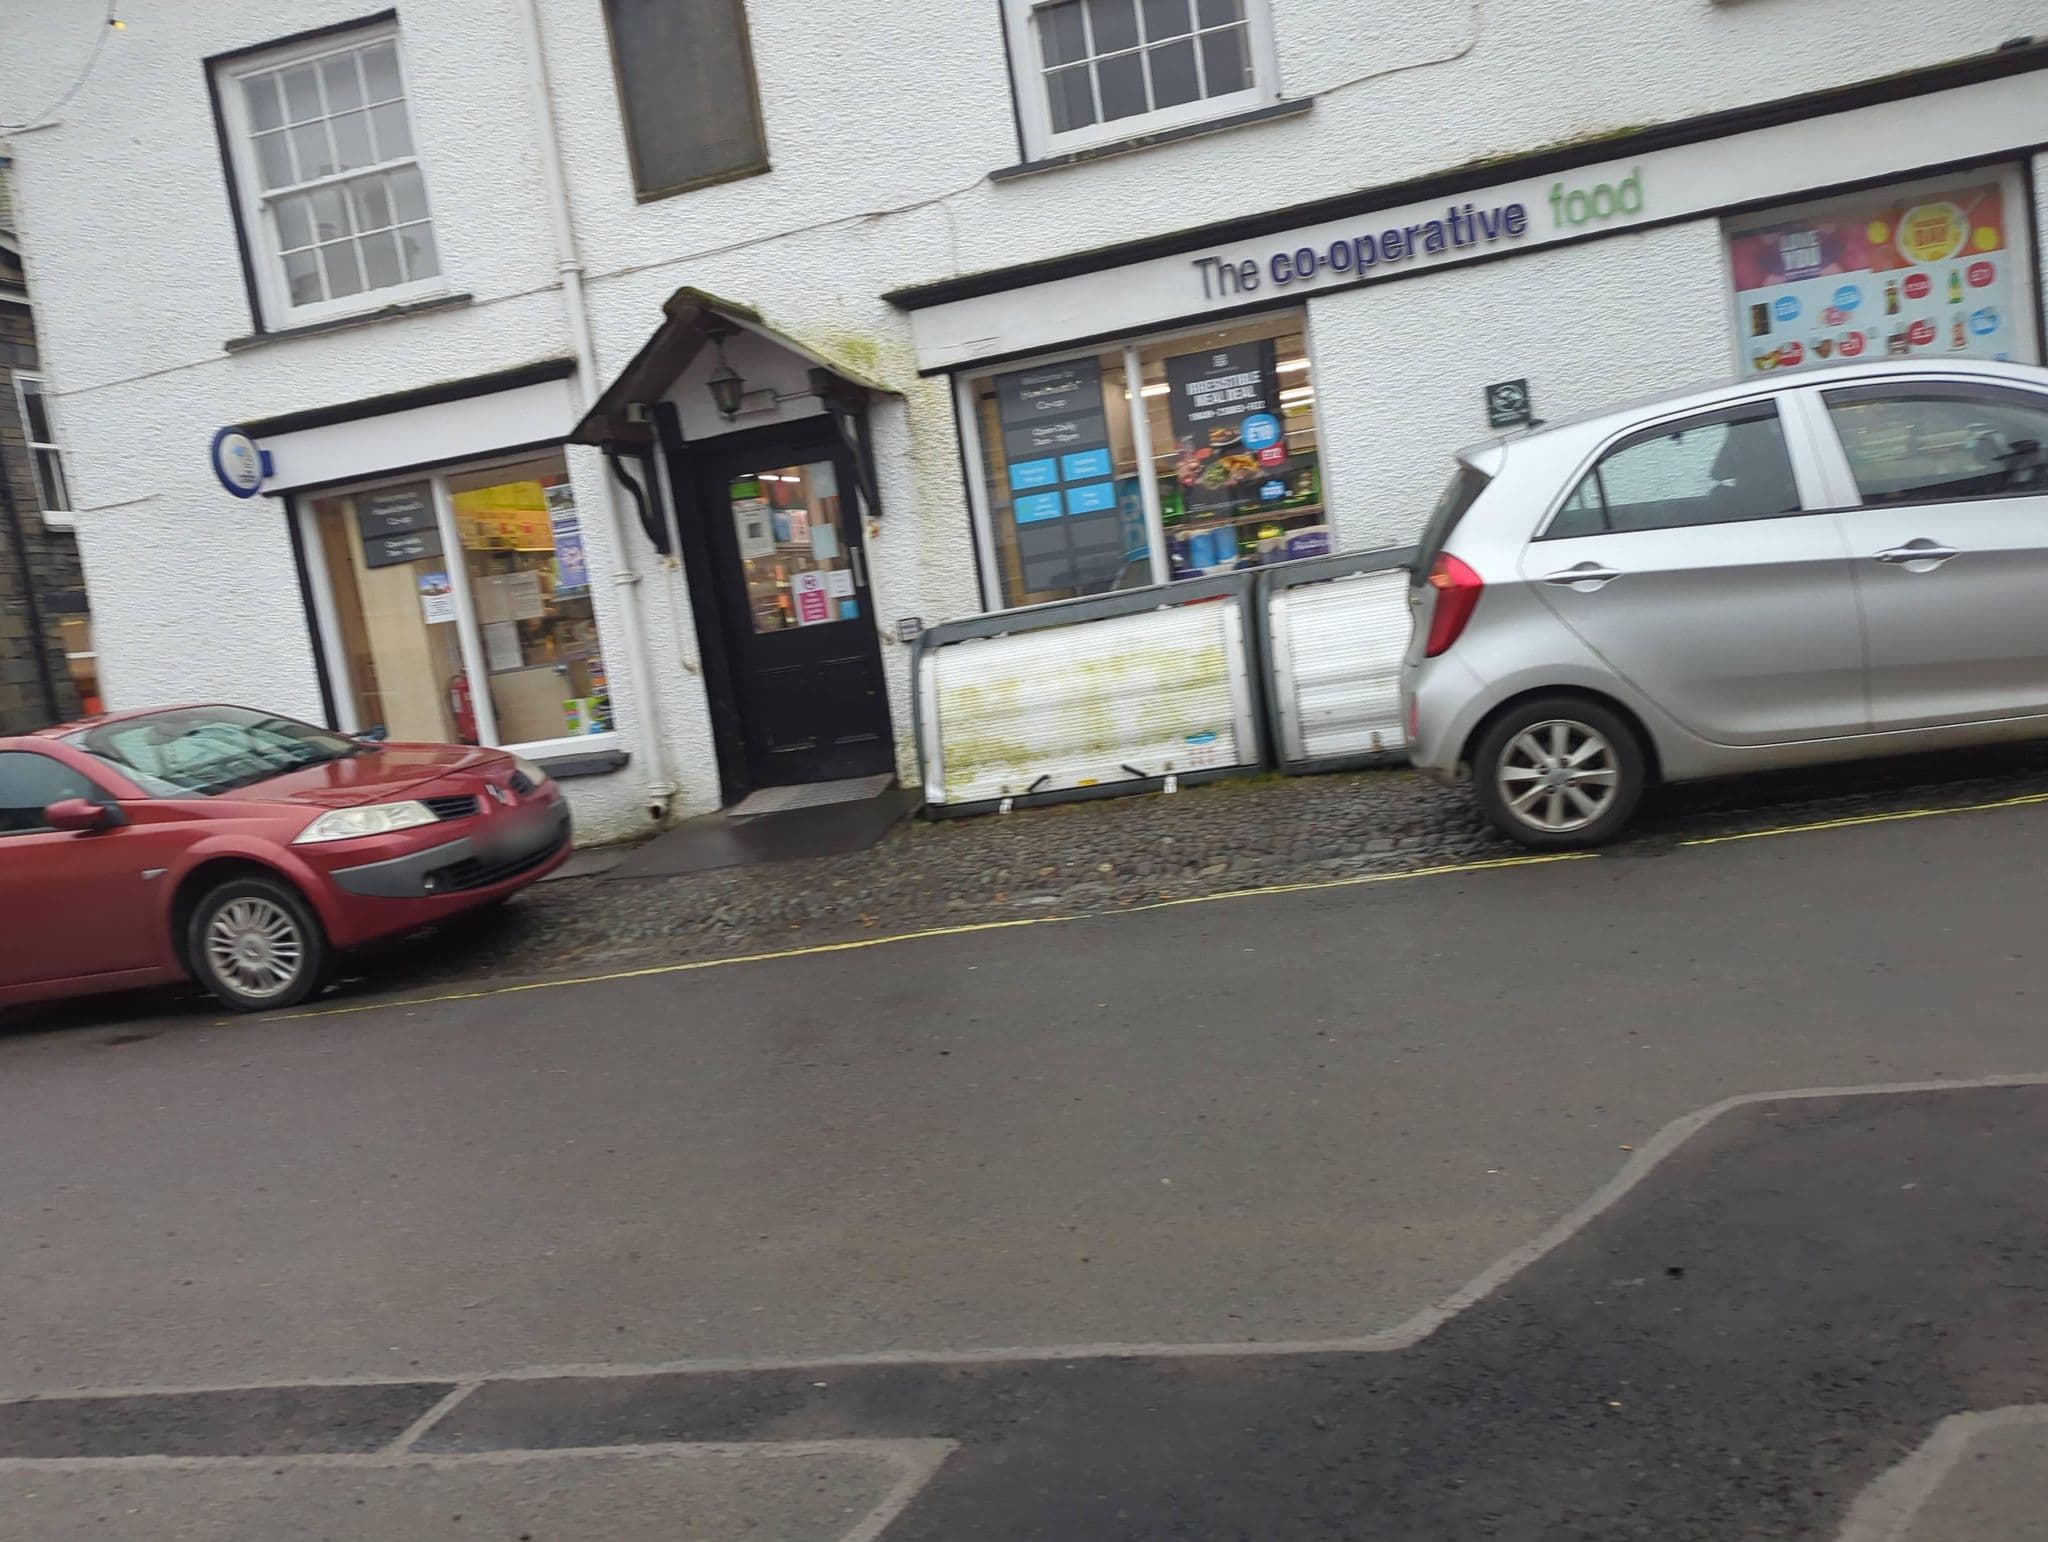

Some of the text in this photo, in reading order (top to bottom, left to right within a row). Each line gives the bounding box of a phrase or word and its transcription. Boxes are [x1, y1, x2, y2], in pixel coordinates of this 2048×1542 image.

[1192, 165, 1643, 299] The co-operative food
